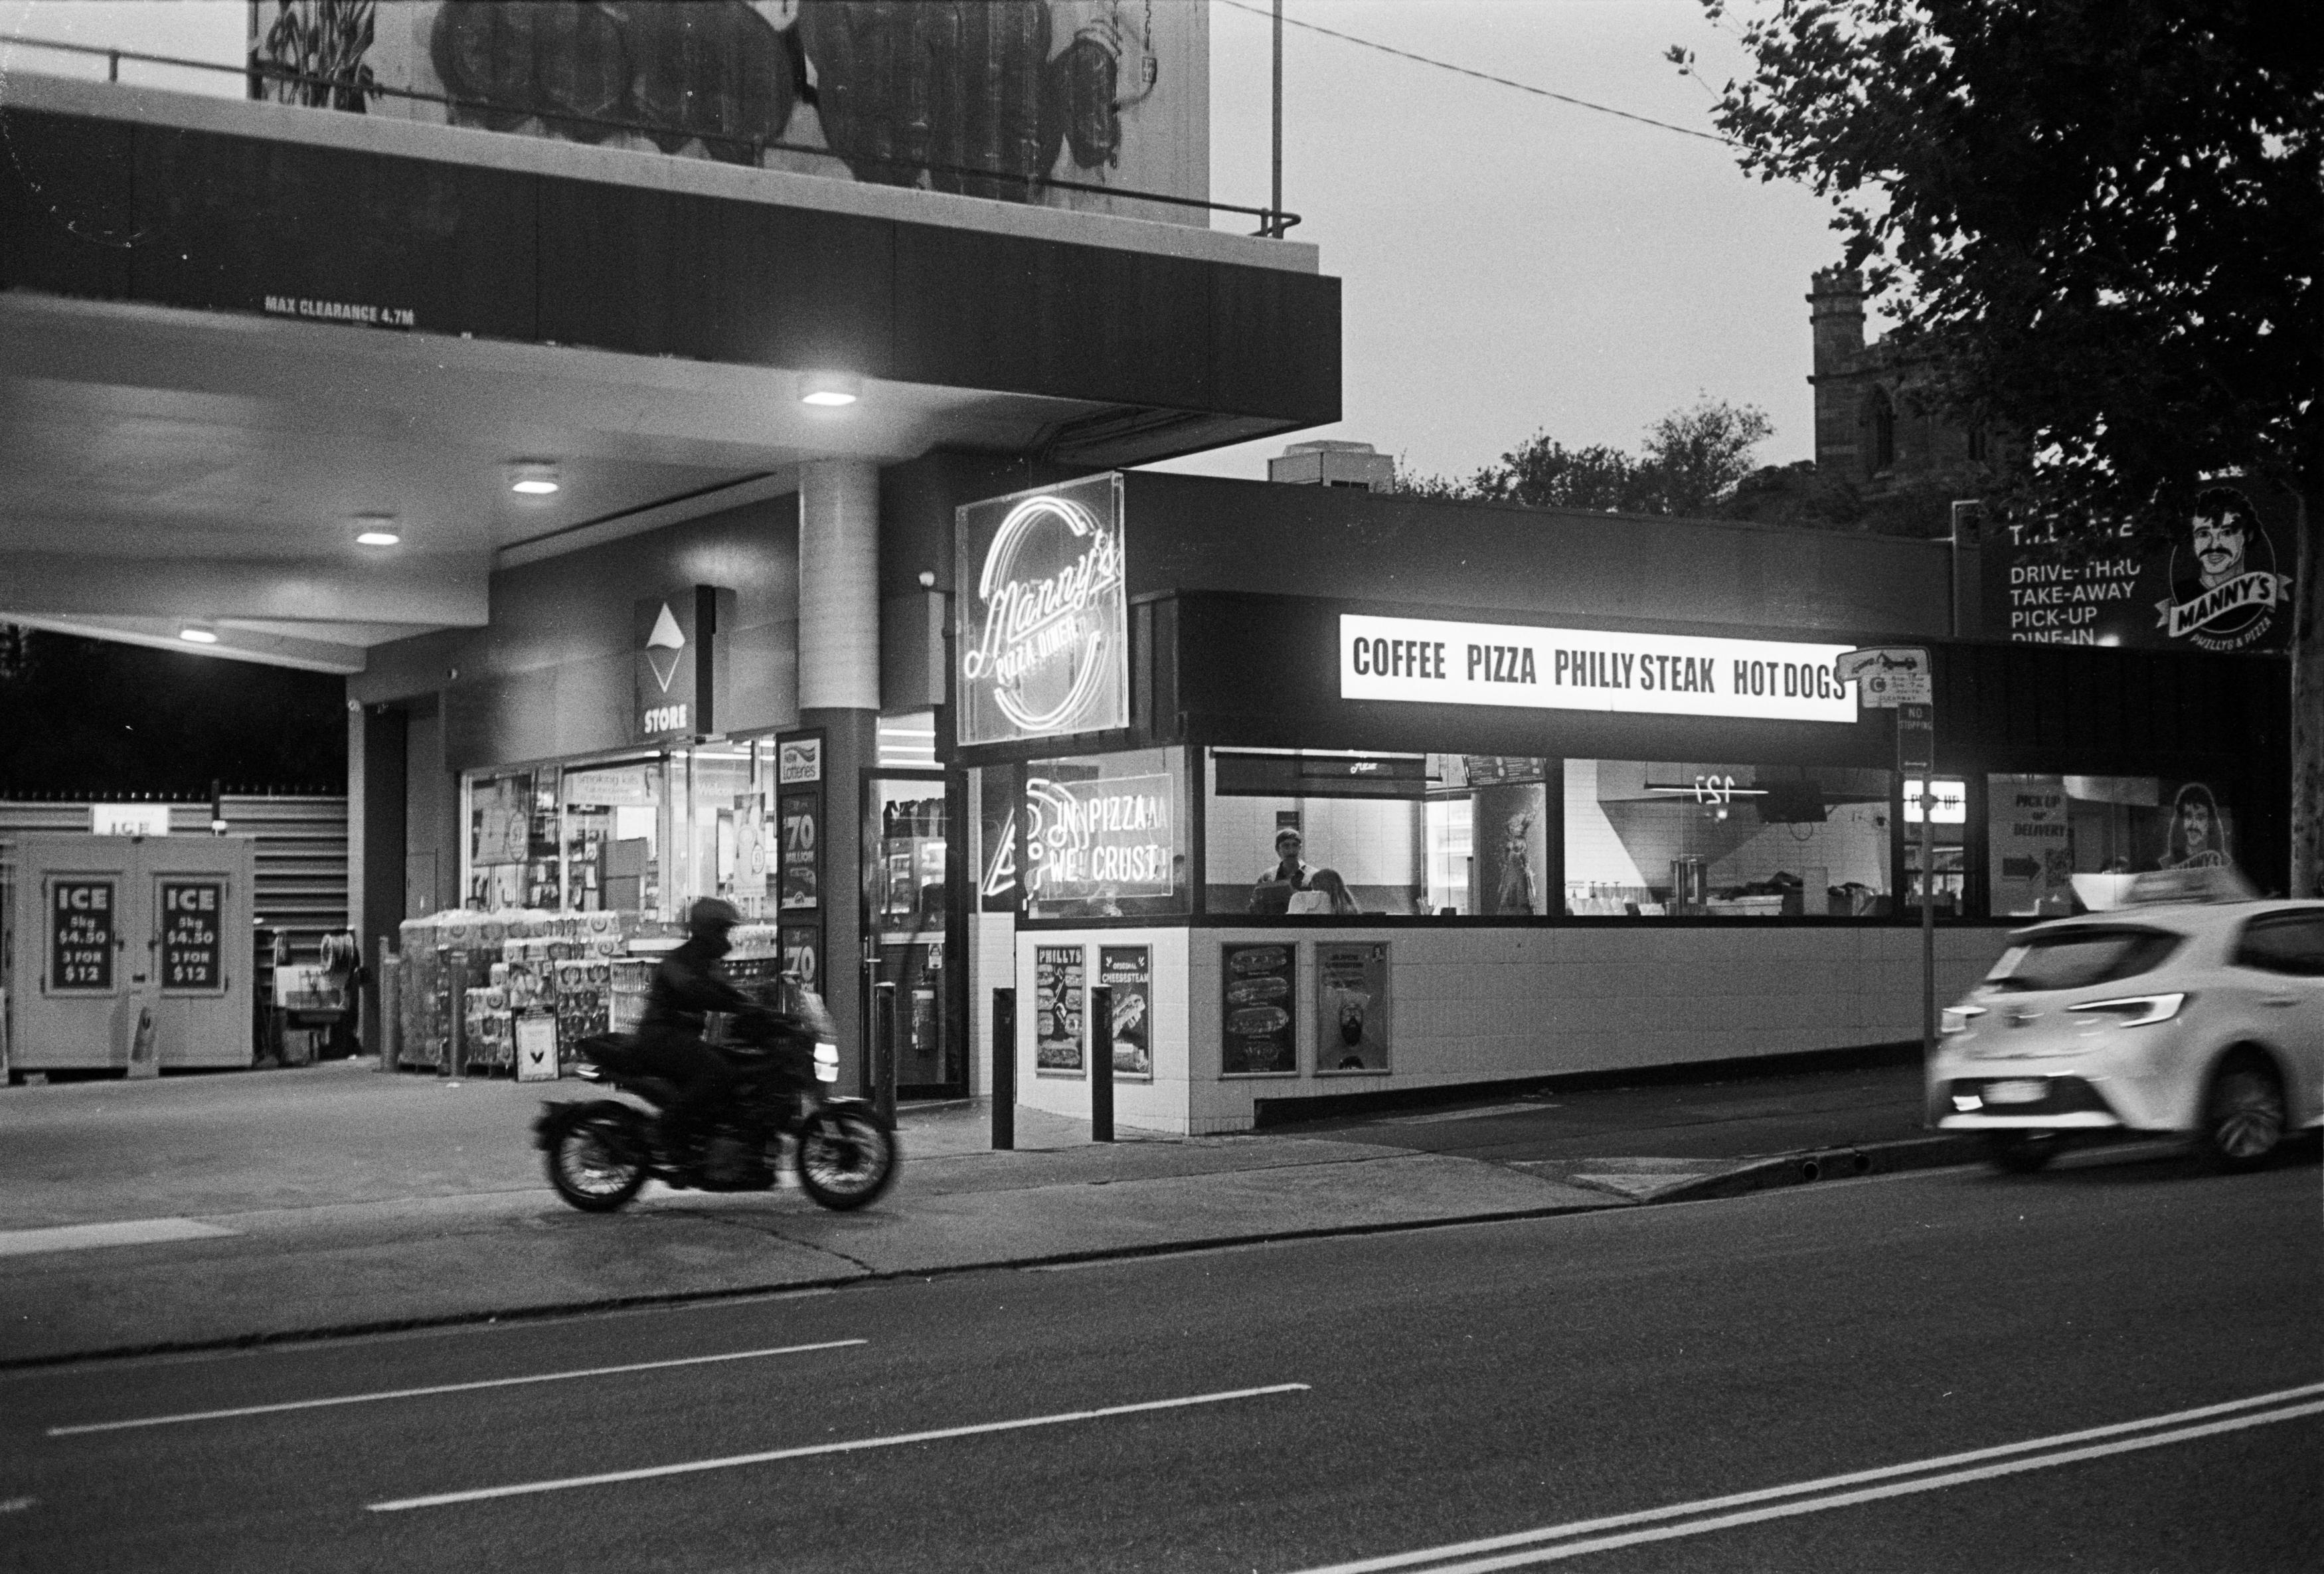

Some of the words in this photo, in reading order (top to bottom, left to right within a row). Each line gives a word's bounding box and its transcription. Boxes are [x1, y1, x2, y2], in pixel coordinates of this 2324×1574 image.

[265, 296, 295, 313] MAX
[299, 300, 377, 322] CLEARANCE
[2011, 559, 2141, 584] DRIVE-THRU
[2011, 581, 2135, 606] TAKE-AWAY
[964, 528, 1117, 680] Manny's
[2178, 575, 2270, 632] MANNY'S
[2012, 607, 2098, 628] PICK-UP
[2236, 638, 2243, 648] &
[2244, 616, 2272, 644] PIZZA
[995, 638, 1037, 684] PIZZA
[1037, 615, 1078, 658] DINER
[1353, 636, 1446, 680] COFFEE
[1467, 644, 1537, 685] PIZZA
[1555, 649, 1635, 689] PHILLY
[1640, 654, 1715, 694] STEAK
[1734, 659, 1780, 696] HOT
[645, 705, 687, 733] STORE
[1908, 707, 1923, 719] NO
[1899, 721, 1932, 731] STOPPING
[1944, 794, 1960, 810] UP
[2016, 794, 2042, 808] PICK
[2044, 794, 2061, 808] UP
[1057, 800, 1077, 835] IN
[1089, 794, 1147, 833] PIZZA
[112, 822, 149, 835] ICE
[2013, 823, 2065, 837] DELIVERY
[786, 850, 814, 863] MILLION
[1049, 847, 1079, 882] WE
[1093, 845, 1159, 882] CRUST
[59, 889, 107, 910] ICE
[167, 889, 214, 910] ICE
[70, 915, 96, 930] 5kg
[179, 915, 203, 931] 5kg
[59, 930, 106, 945] $4.50
[167, 930, 214, 945] $4.50
[62, 950, 71, 963] 3
[75, 951, 102, 963] FOR
[171, 950, 179, 963] 3
[183, 951, 210, 963] FOR
[1039, 949, 1082, 964] PHILLYS
[66, 966, 99, 982] $12
[173, 965, 207, 982] $12
[1102, 972, 1149, 984] CHEESESTEAK
